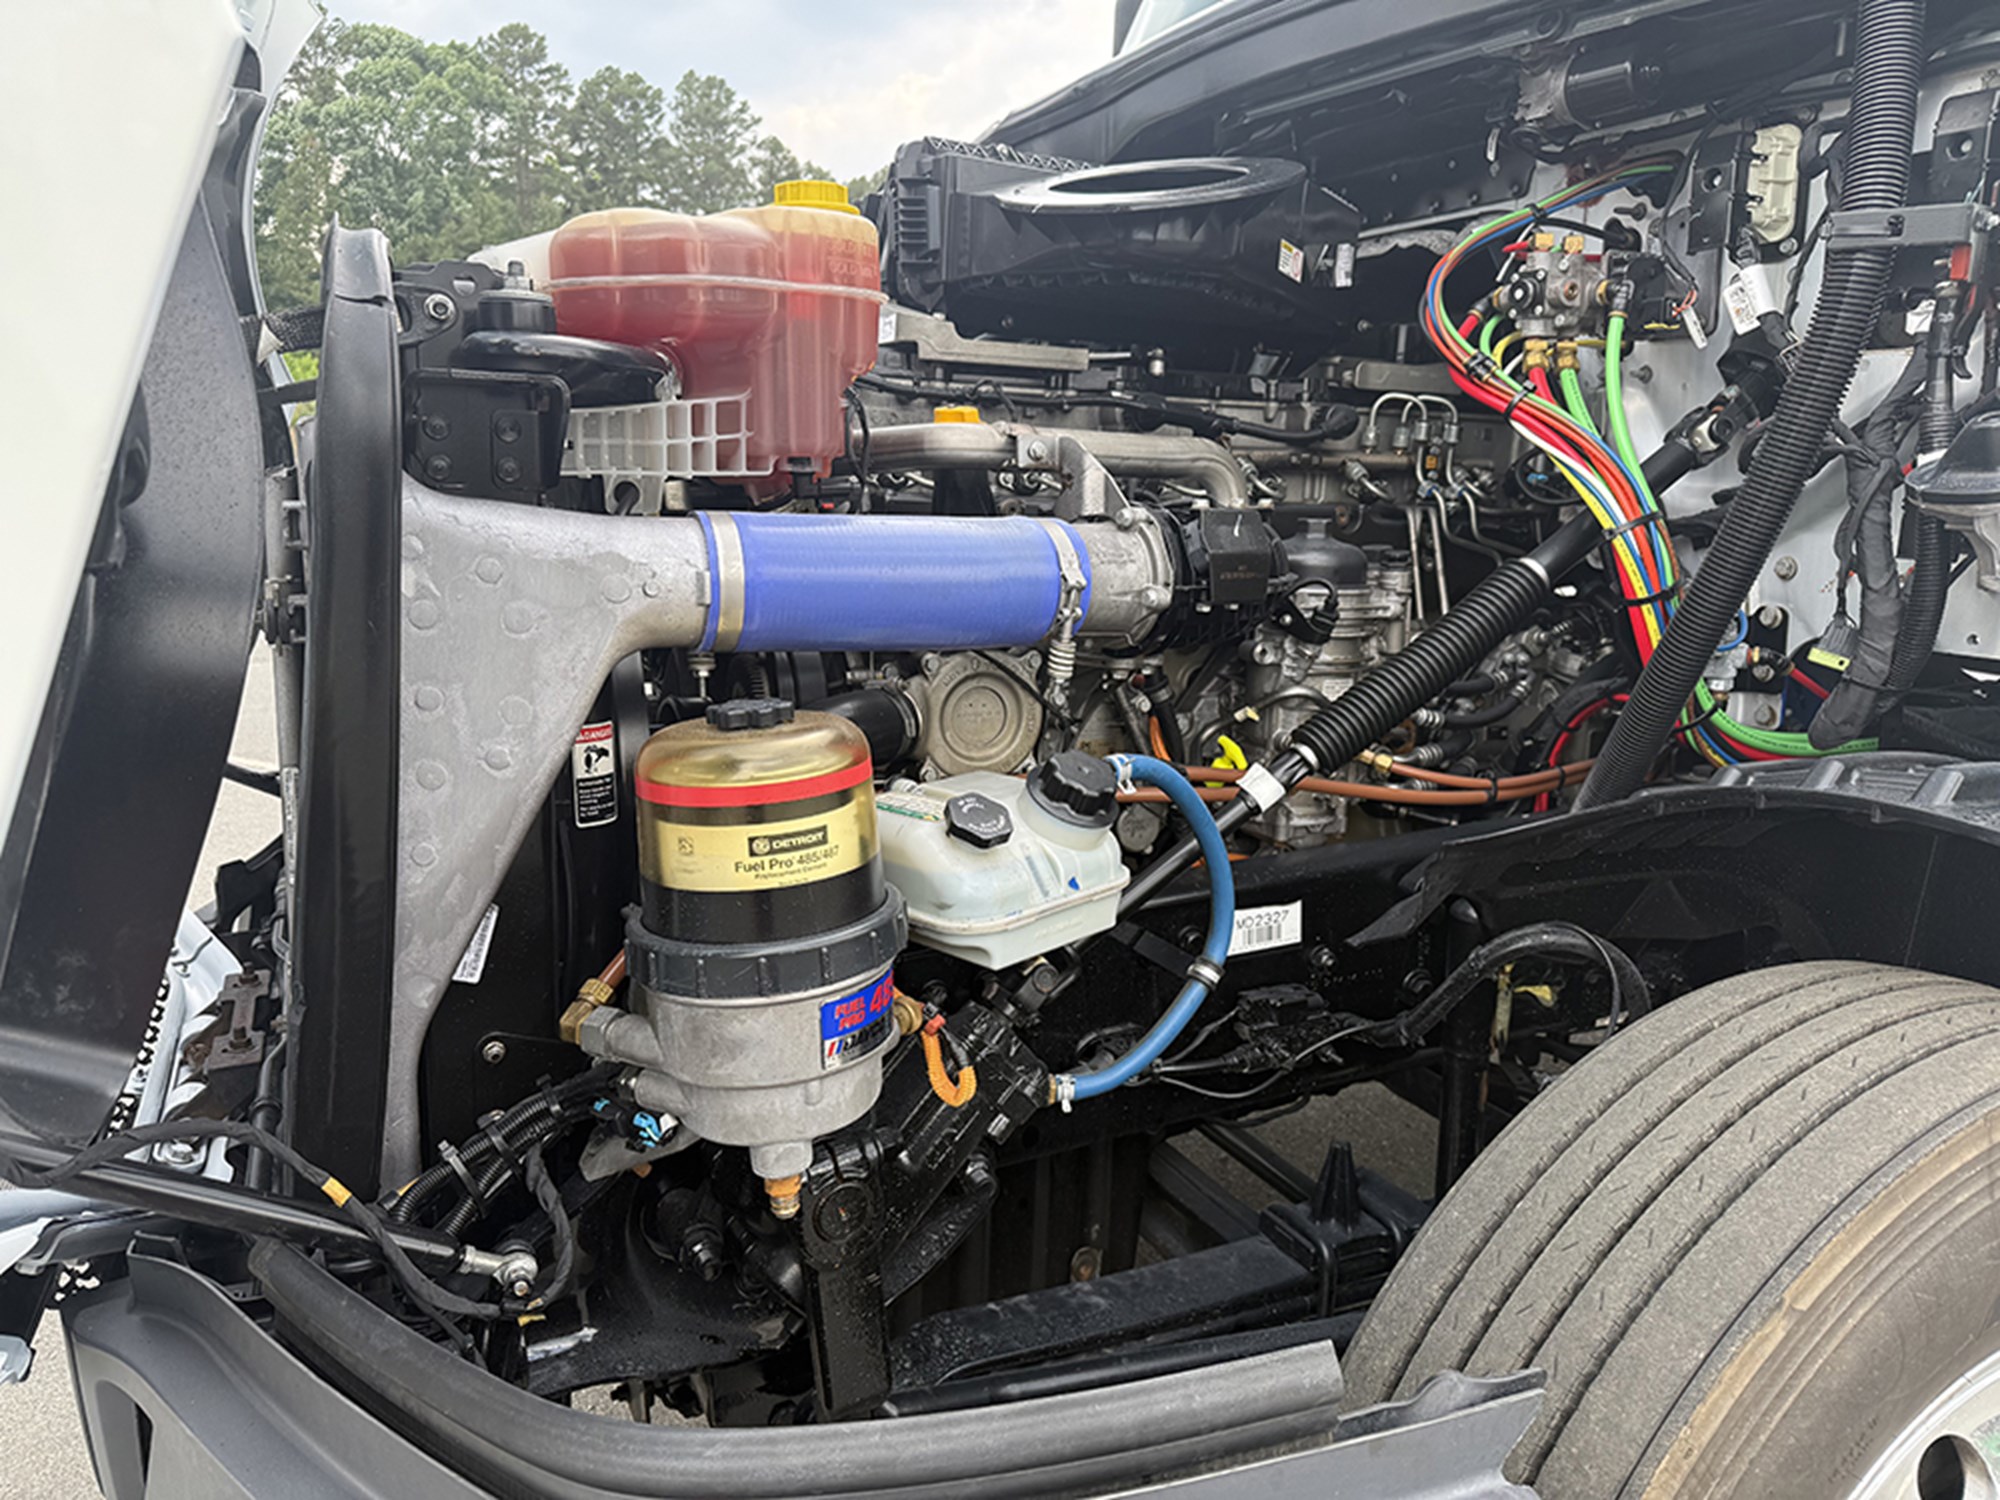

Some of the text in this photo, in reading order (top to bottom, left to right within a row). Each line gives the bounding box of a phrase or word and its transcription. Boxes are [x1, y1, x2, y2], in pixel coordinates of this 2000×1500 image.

[772, 831, 824, 850] DETROIT
[734, 860, 765, 873] Fuel
[768, 857, 794, 870] Pro
[835, 996, 866, 1019] FUEL
[838, 1010, 866, 1031] PRO
